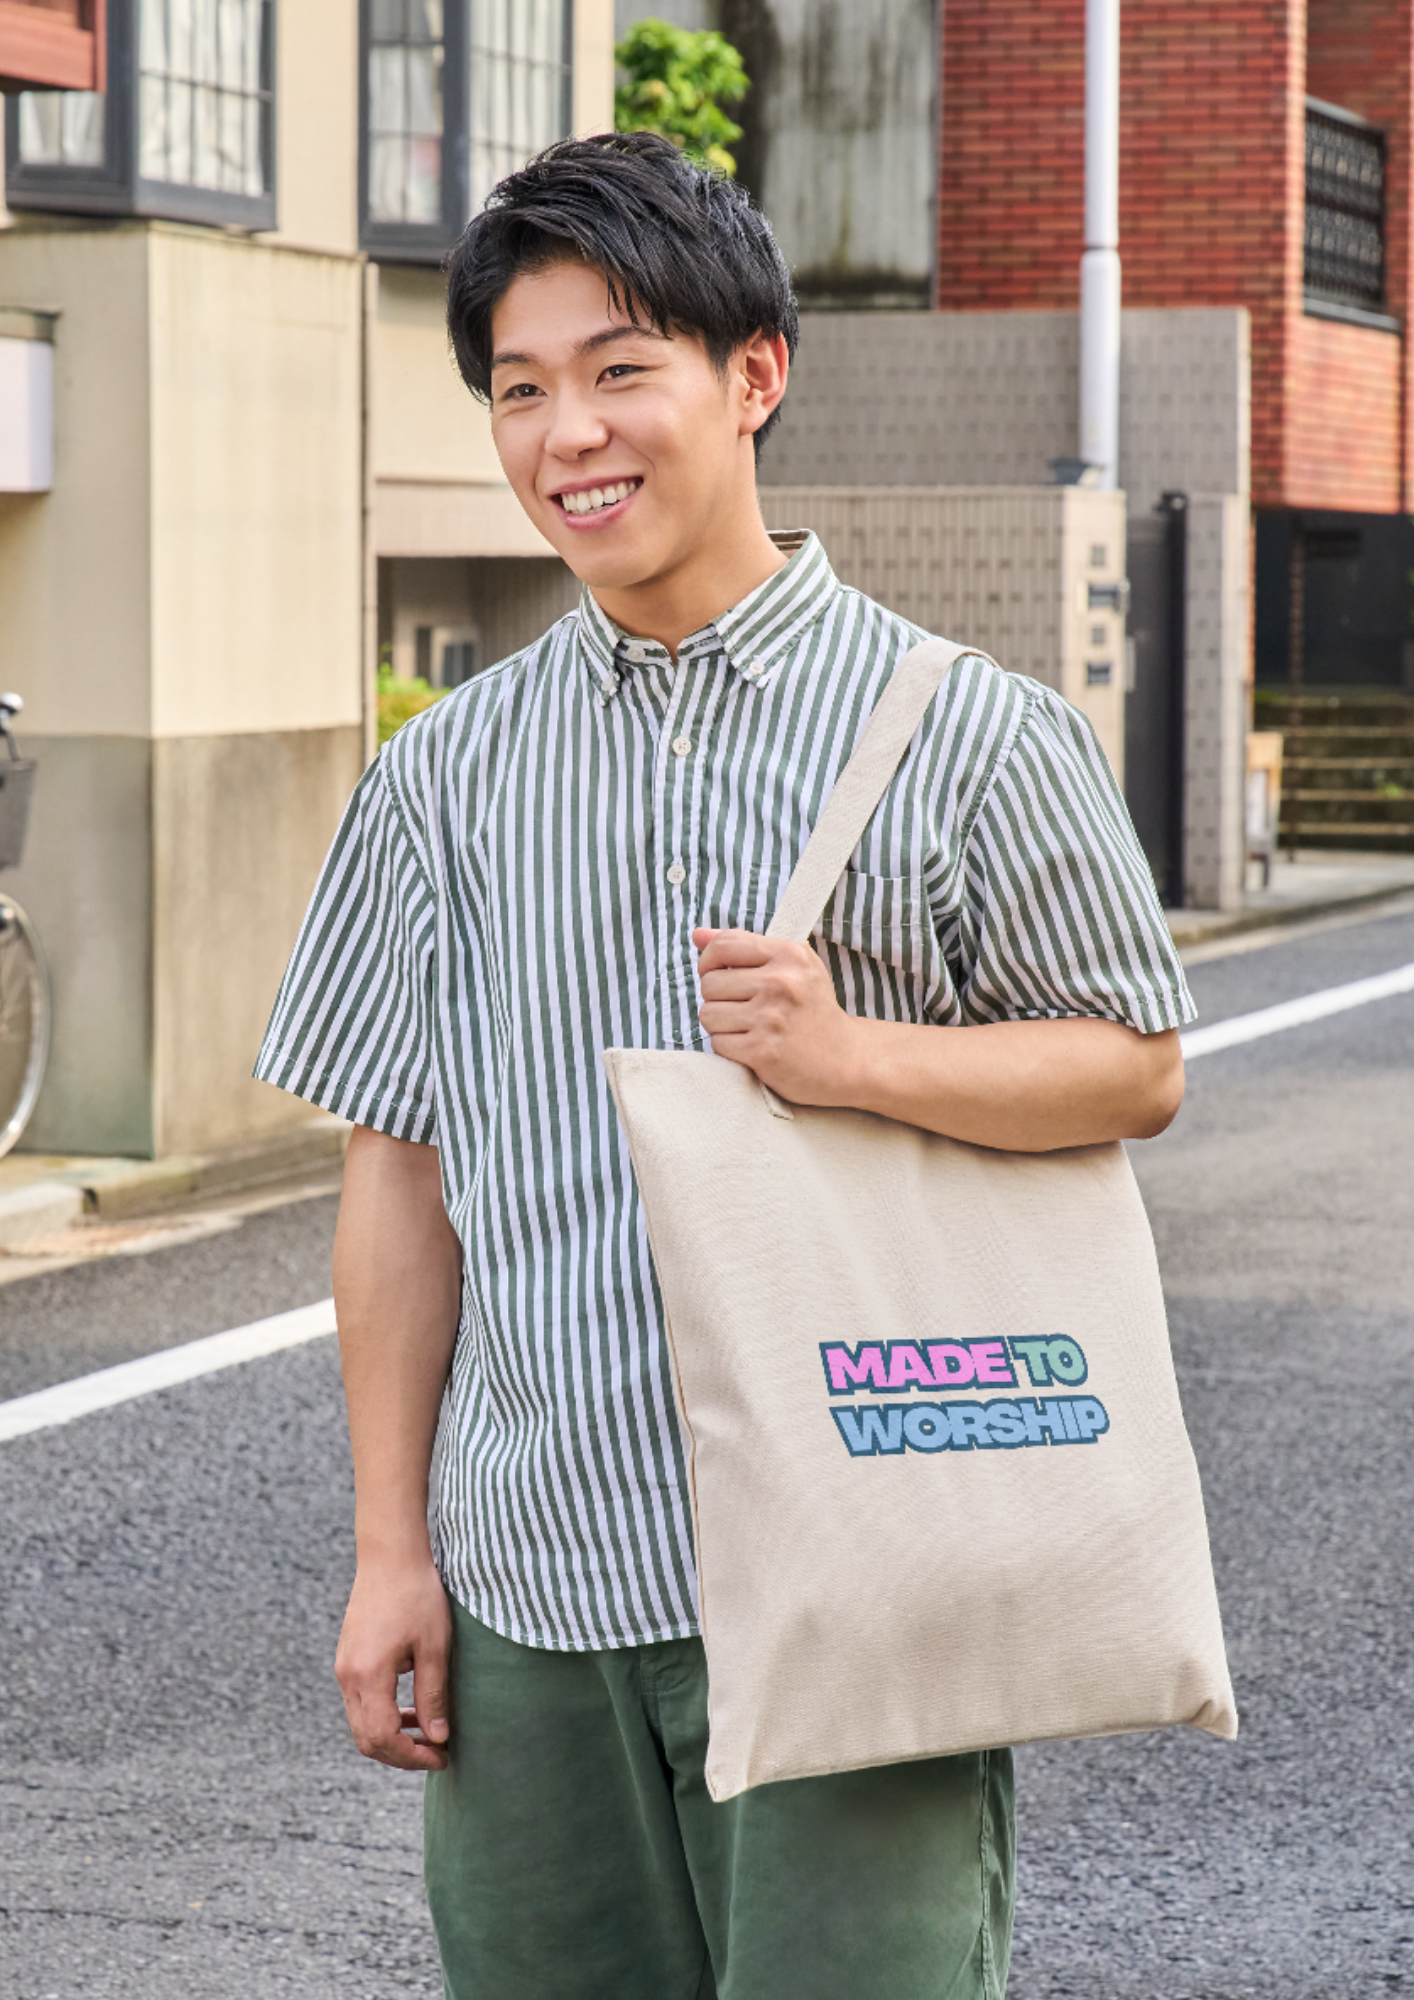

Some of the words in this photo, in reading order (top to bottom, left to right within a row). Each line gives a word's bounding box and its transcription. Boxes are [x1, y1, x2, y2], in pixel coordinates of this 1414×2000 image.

[819, 1336, 1020, 1395] MADE
[1007, 1333, 1088, 1387] TO
[829, 1395, 1110, 1457] WORSHIP
